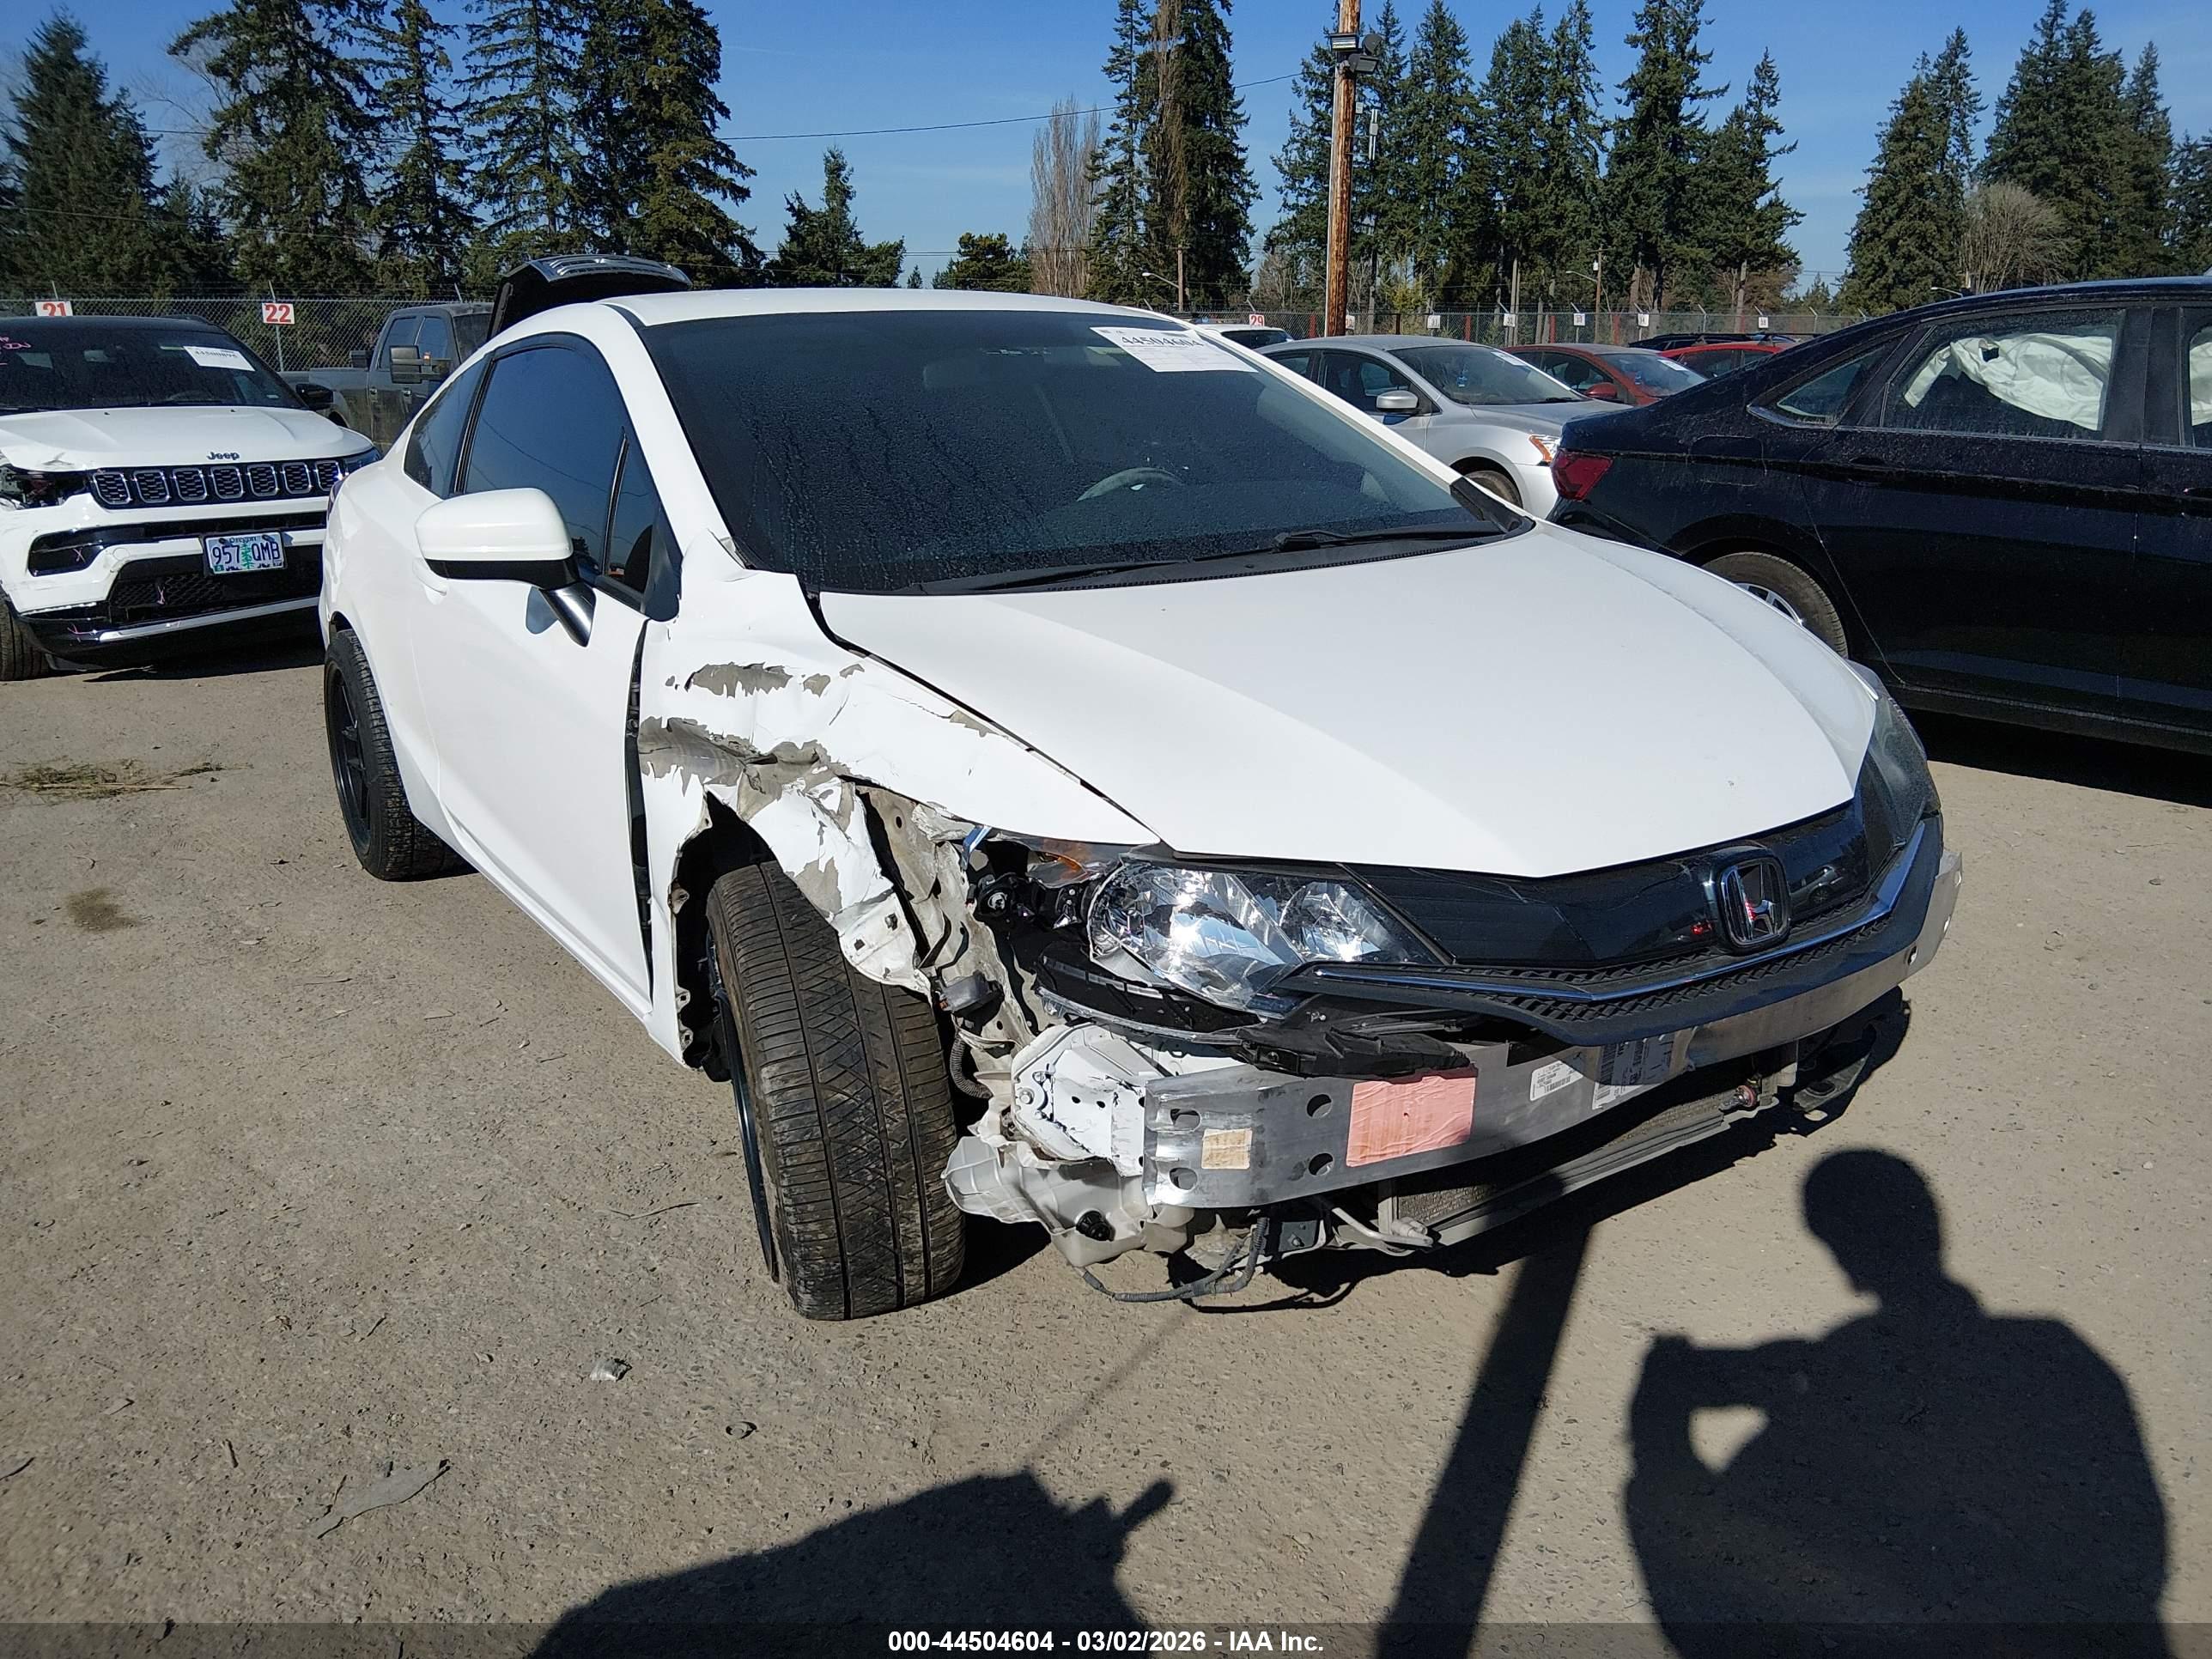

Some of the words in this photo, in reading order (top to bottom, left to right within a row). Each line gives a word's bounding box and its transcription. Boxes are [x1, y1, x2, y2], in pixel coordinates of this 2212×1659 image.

[42, 301, 67, 317] 21
[264, 303, 292, 323] 22
[1250, 314, 1264, 326] 29
[206, 451, 240, 461] Jeep
[212, 544, 240, 565] 957
[251, 541, 281, 562] QMB
